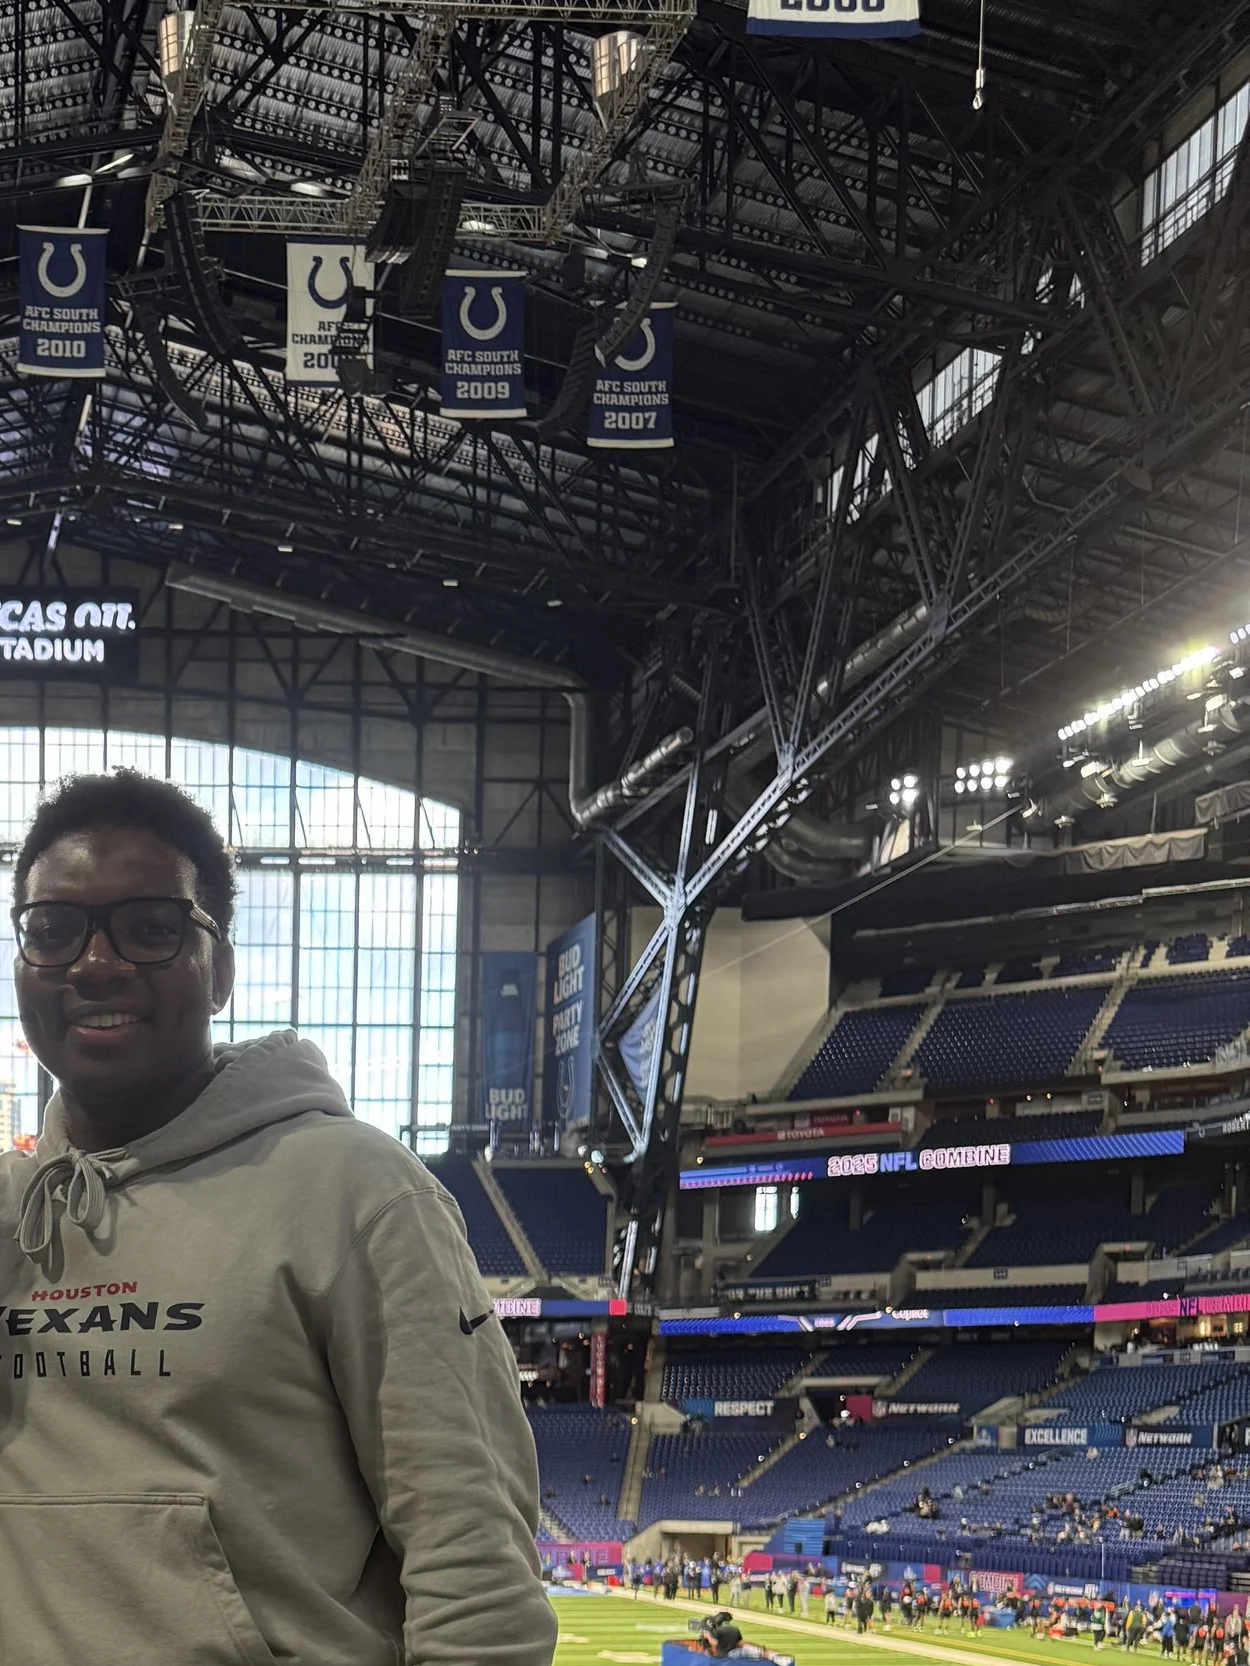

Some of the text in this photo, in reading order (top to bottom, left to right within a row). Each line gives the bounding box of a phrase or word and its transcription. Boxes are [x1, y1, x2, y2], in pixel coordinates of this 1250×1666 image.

[25, 305, 99, 320] AFC SOUTH
[22, 317, 101, 334] CHAMPIONS
[36, 338, 86, 358] 2010
[303, 352, 340, 369] 200
[447, 350, 519, 364] AFC SOUTH
[445, 361, 522, 376] CHAMPIONS
[456, 381, 510, 399] 2009
[595, 379, 666, 393] AFC SOUTH
[593, 391, 669, 406] CHAMPIONS
[604, 412, 656, 430] 2007
[558, 943, 581, 978] BUD
[554, 966, 584, 1004] LIGHT
[552, 1000, 583, 1037] PARTY
[555, 1025, 579, 1056] ZONE
[489, 1088, 525, 1104] BUD
[485, 1103, 529, 1121] LIGHT
[786, 1127, 825, 1140] TOYOTA
[827, 1144, 1011, 1177] 2025 NFL COMBINE
[31, 1281, 138, 1301] HOUSTON
[1180, 1297, 1200, 1317] NFL
[714, 1400, 774, 1417] RESPECT
[888, 1402, 960, 1415] NETWORK
[1024, 1426, 1087, 1446] EXCELLENCE
[1138, 1431, 1193, 1445] NETWORK
